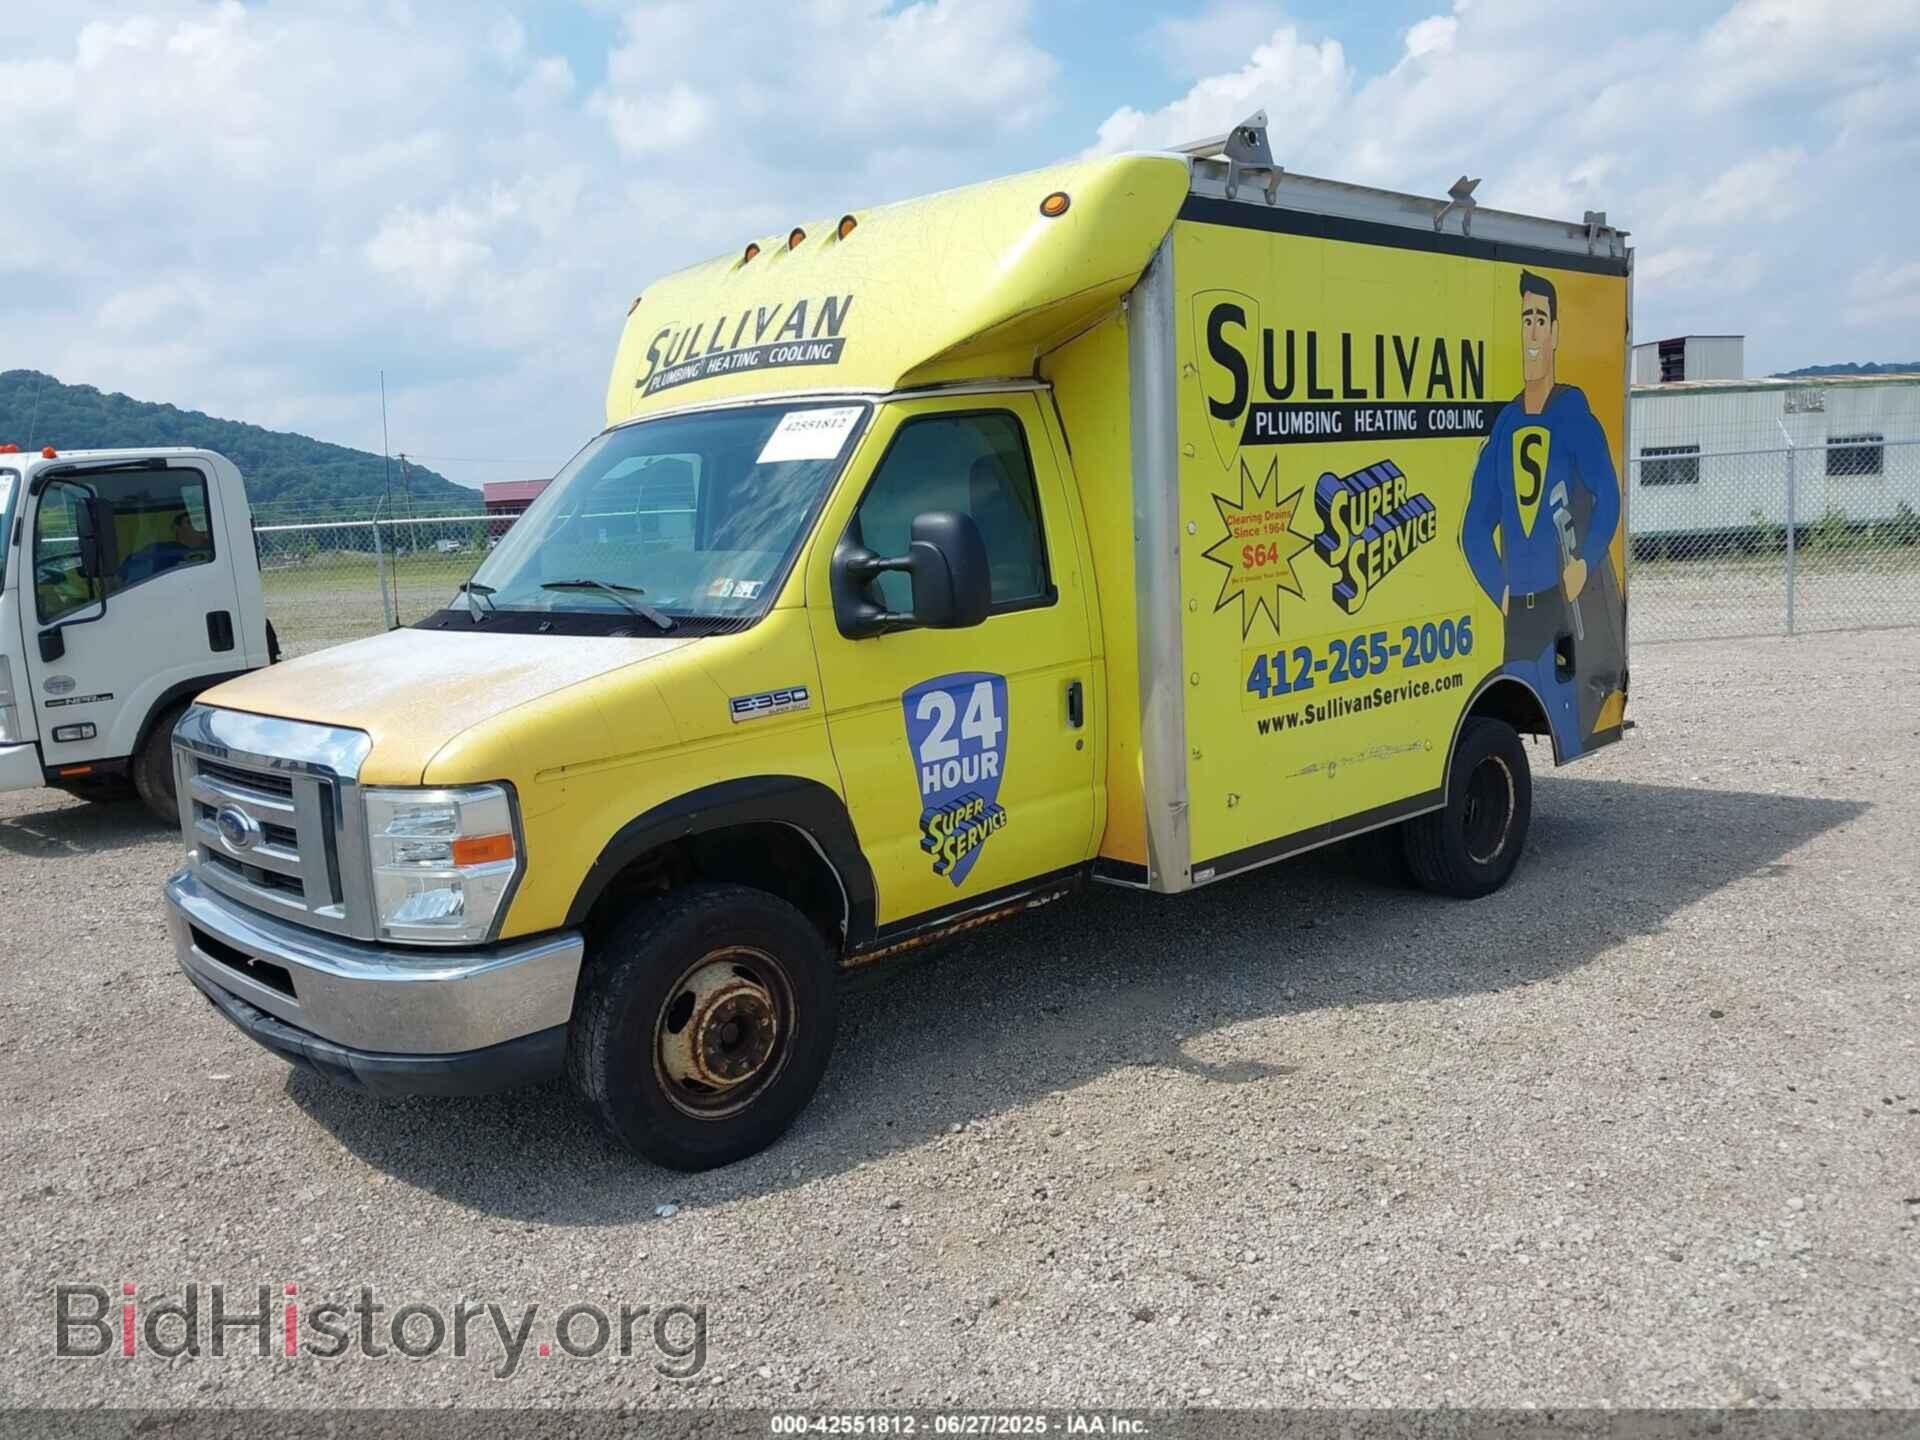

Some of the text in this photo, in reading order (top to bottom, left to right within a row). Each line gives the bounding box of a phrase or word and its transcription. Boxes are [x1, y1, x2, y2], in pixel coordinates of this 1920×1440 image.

[635, 294, 854, 388] SULLIVAN
[650, 343, 833, 390] PLUMBING HEATING COOLING
[1206, 302, 1485, 421] SULLIVAN
[1255, 408, 1485, 435] PLUMBING HEATING COOLING
[1518, 432, 1544, 506] S
[1227, 510, 1291, 526] Clearing Drains
[1233, 527, 1260, 538] Since
[1327, 475, 1407, 567] SUPER
[1242, 542, 1278, 570] $64
[1347, 509, 1437, 615] SERVICE
[1246, 615, 1474, 700] 412-265-2006
[915, 681, 1002, 763] 24
[1257, 671, 1464, 735] www.SullivanService.com
[922, 750, 999, 795] HOUR
[928, 797, 984, 854] SUPER
[943, 810, 1006, 875] SERVICE
